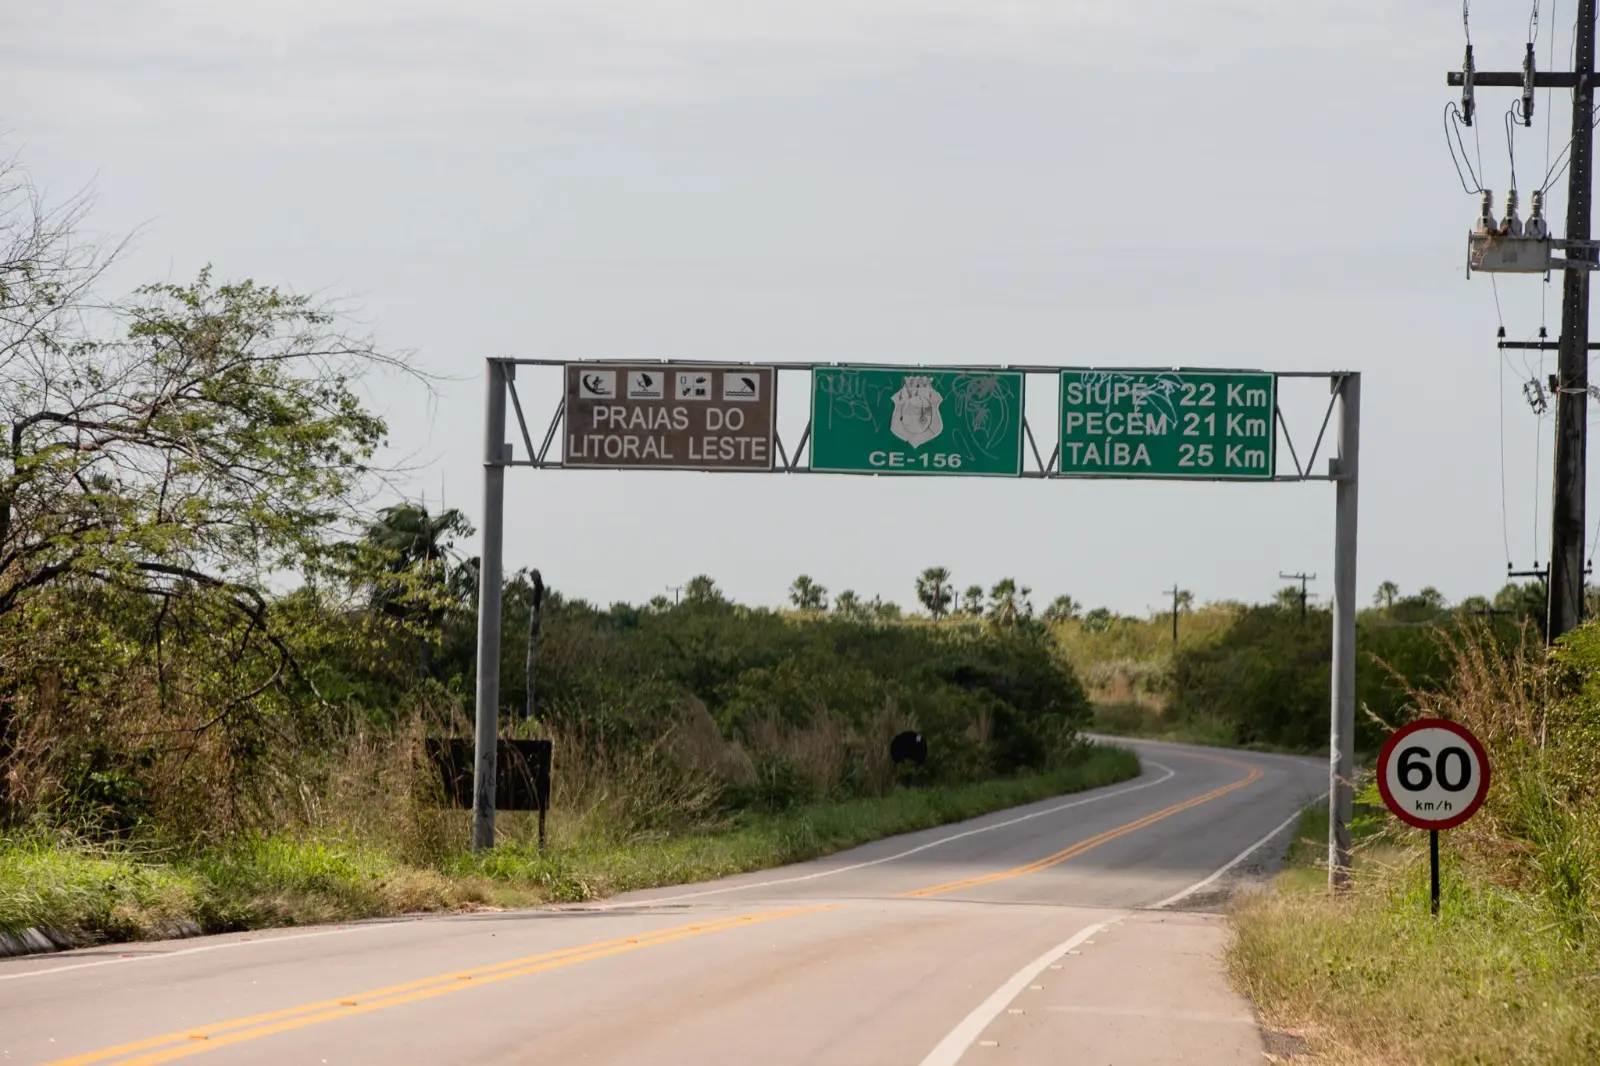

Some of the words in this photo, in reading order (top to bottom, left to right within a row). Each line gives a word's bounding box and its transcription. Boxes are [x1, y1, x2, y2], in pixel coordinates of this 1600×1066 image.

[1067, 377, 1148, 405] SIUPÉ
[1179, 383, 1216, 406] 22
[1226, 383, 1267, 407] Km
[592, 405, 689, 430] PRAIAS
[706, 408, 744, 430] DO
[1183, 413, 1215, 436] 21
[1226, 413, 1266, 437] Km
[569, 434, 673, 459] LITORAL
[688, 436, 767, 460] LESTE
[868, 451, 962, 468] CE-156
[1066, 436, 1151, 466] TAÍBA
[1178, 444, 1214, 466] 25
[1225, 444, 1265, 468] Km
[1397, 746, 1471, 792] 60
[1416, 800, 1452, 811] km/h
